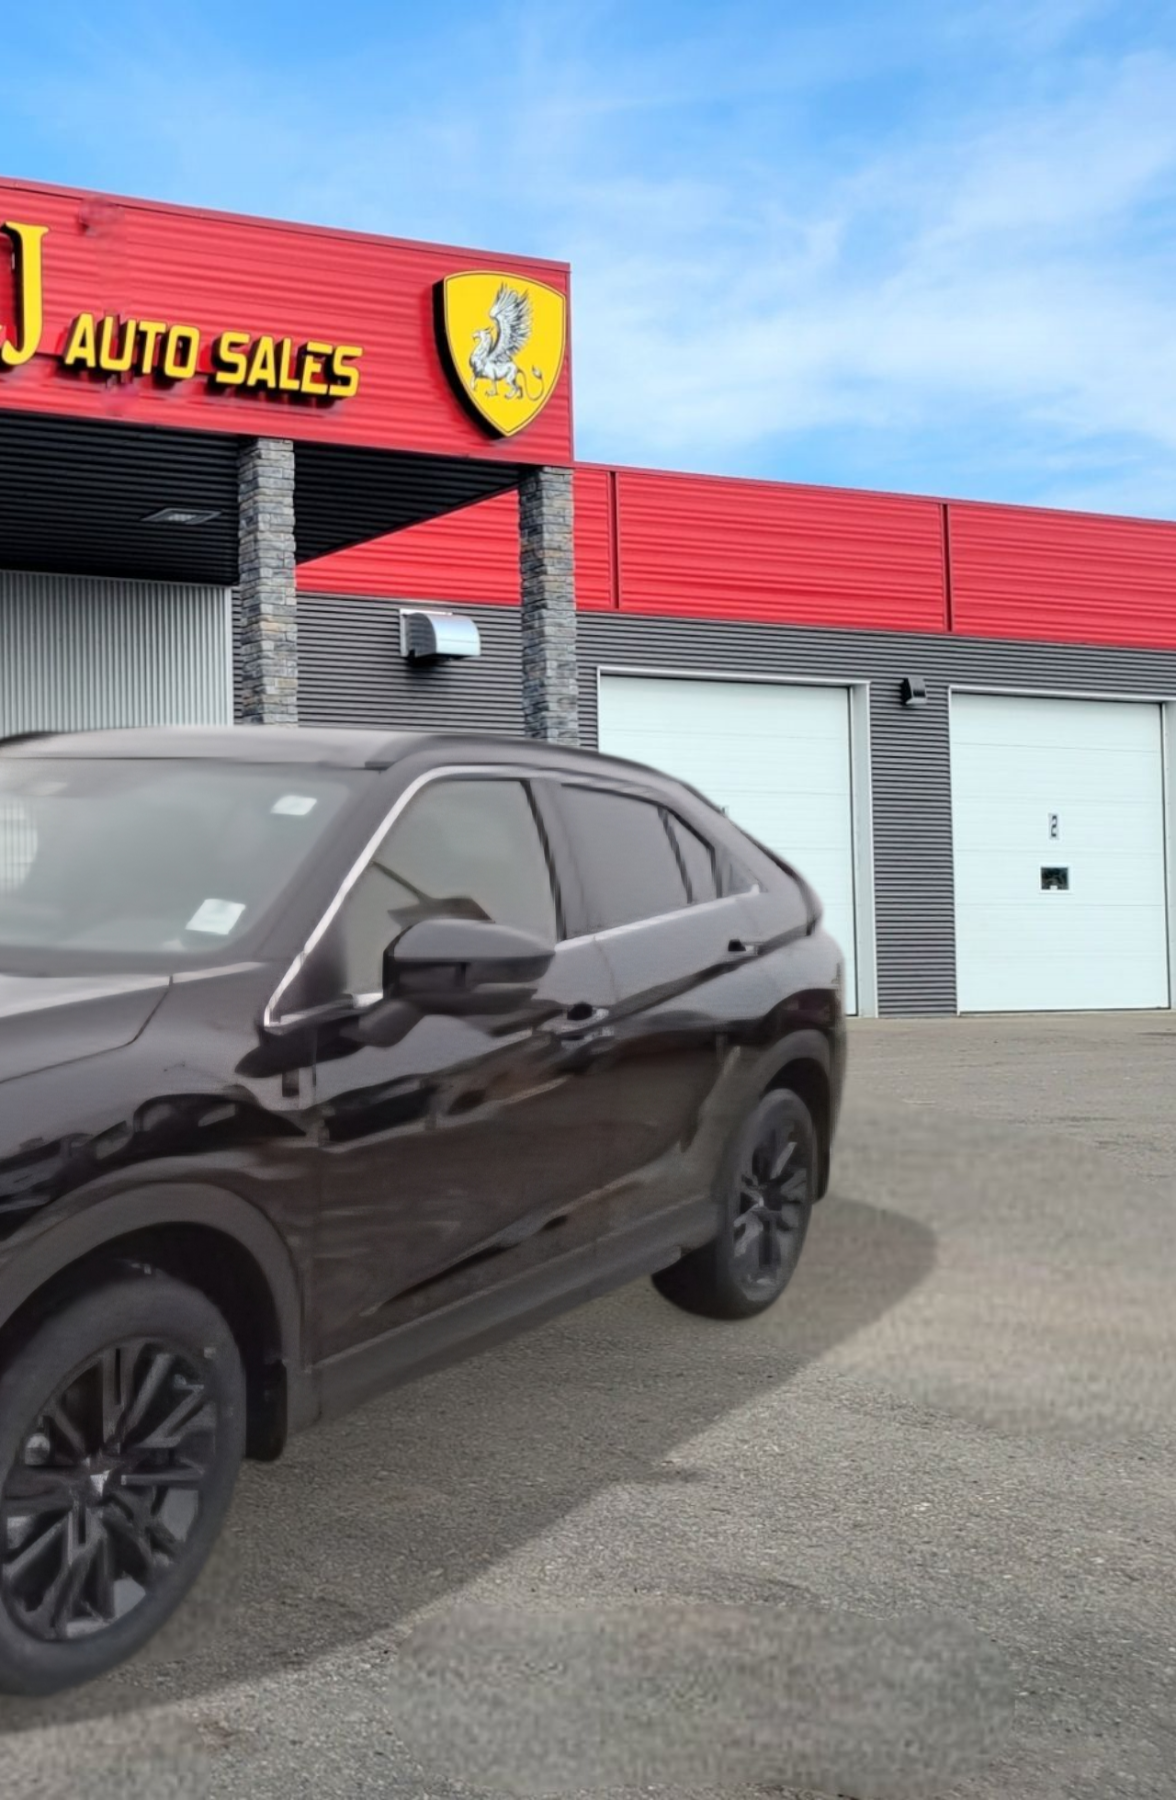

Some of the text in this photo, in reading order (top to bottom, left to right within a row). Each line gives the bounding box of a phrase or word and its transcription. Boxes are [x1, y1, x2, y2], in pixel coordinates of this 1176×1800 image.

[64, 312, 202, 379] AUTO
[215, 330, 364, 398] SALES
[1049, 814, 1059, 838] 2
